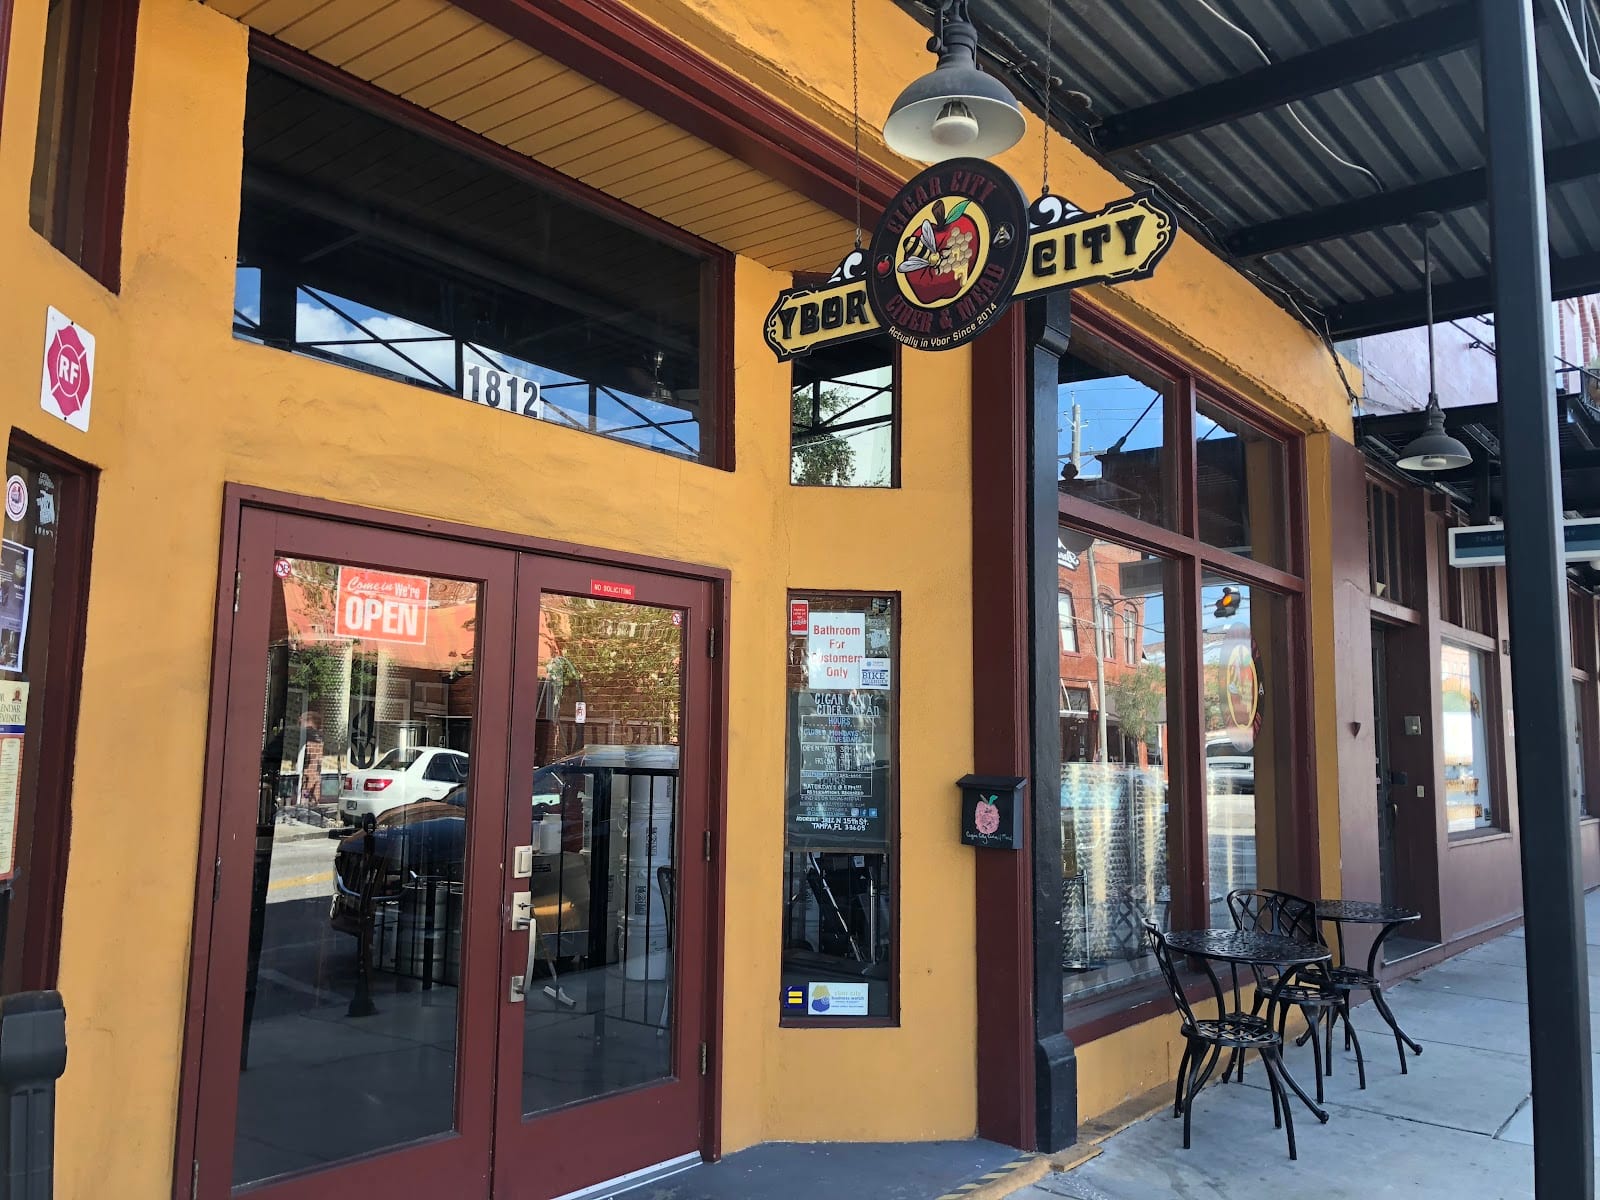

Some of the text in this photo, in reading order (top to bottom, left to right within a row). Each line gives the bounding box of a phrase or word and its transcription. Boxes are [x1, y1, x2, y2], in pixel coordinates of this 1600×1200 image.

[886, 171, 997, 234] CIGAR CITY
[1032, 214, 1145, 278] CITY
[885, 263, 1005, 334] CIDER & MEAD
[776, 289, 870, 341] YBOR
[888, 302, 997, 348] Actually in Ybor Since 2014
[59, 354, 80, 385] RF
[468, 365, 538, 418] 1812
[347, 576, 421, 599] Come in We're
[603, 585, 632, 596] SOLICITING
[345, 596, 419, 637] OPEN
[813, 625, 860, 636] Bathroom
[829, 639, 845, 649] For
[826, 667, 848, 679] Only
[815, 692, 844, 705] CIGAR
[816, 705, 842, 716] CIDER
[828, 716, 851, 725] HOURS
